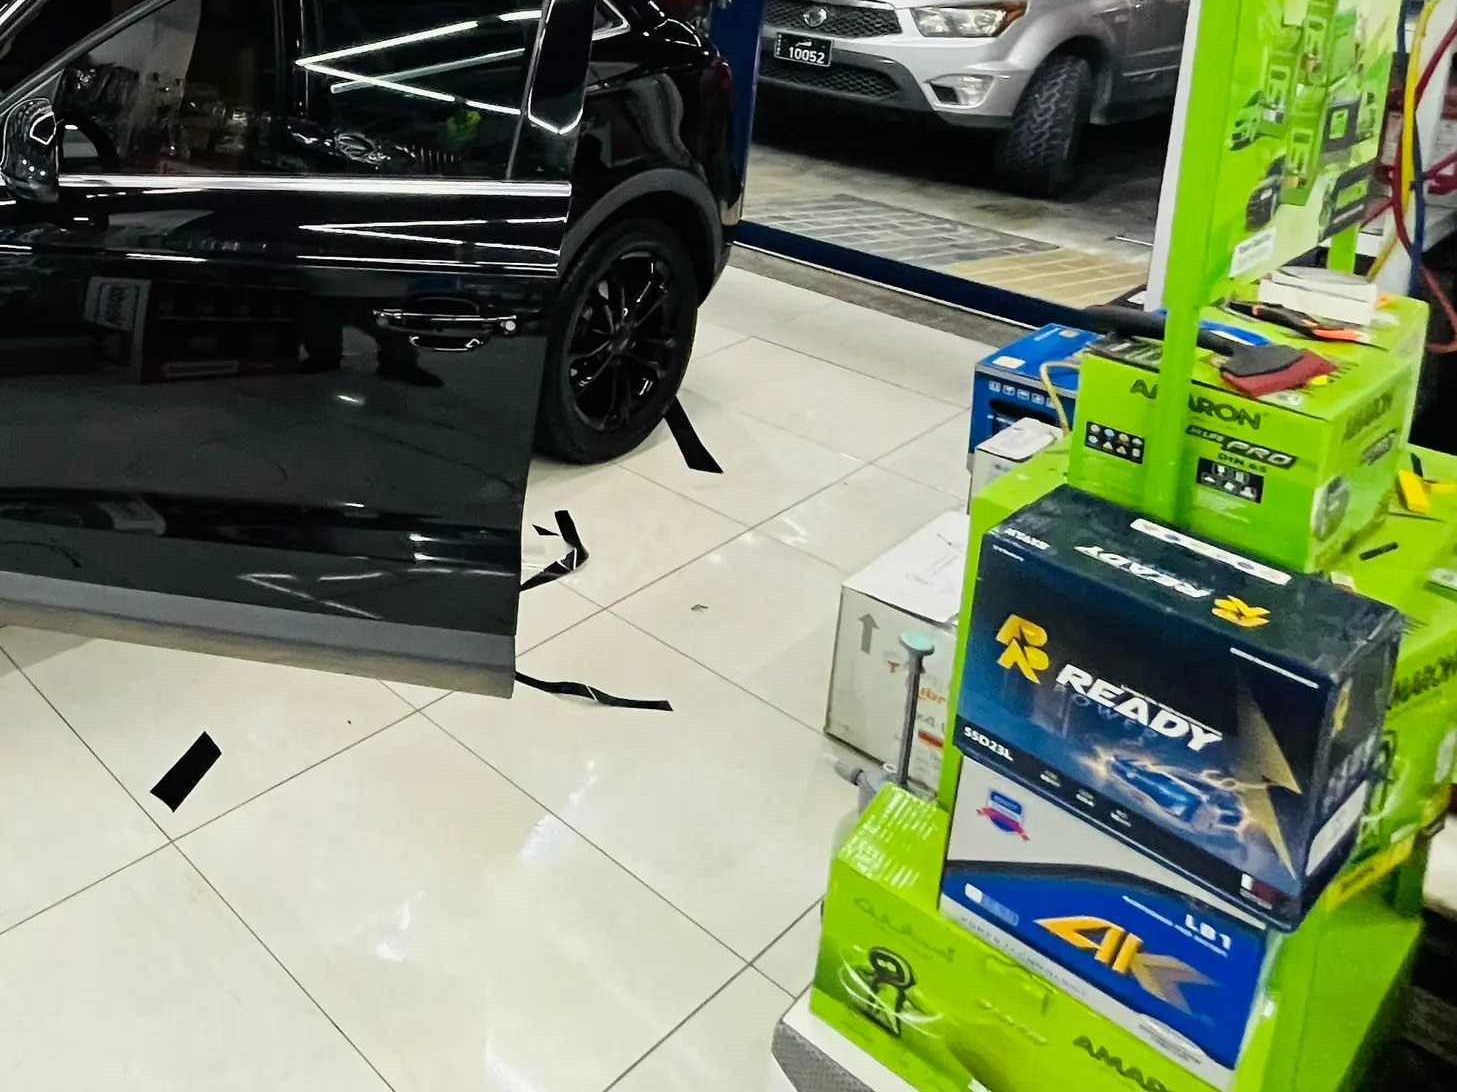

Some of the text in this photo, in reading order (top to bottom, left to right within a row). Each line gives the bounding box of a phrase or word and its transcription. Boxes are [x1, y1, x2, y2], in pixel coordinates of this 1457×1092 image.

[789, 47, 825, 64] 10052
[1130, 378, 1261, 430] ARON
[1226, 439, 1293, 465] PRO
[1074, 545, 1215, 599] READY
[1055, 664, 1224, 751] READY
